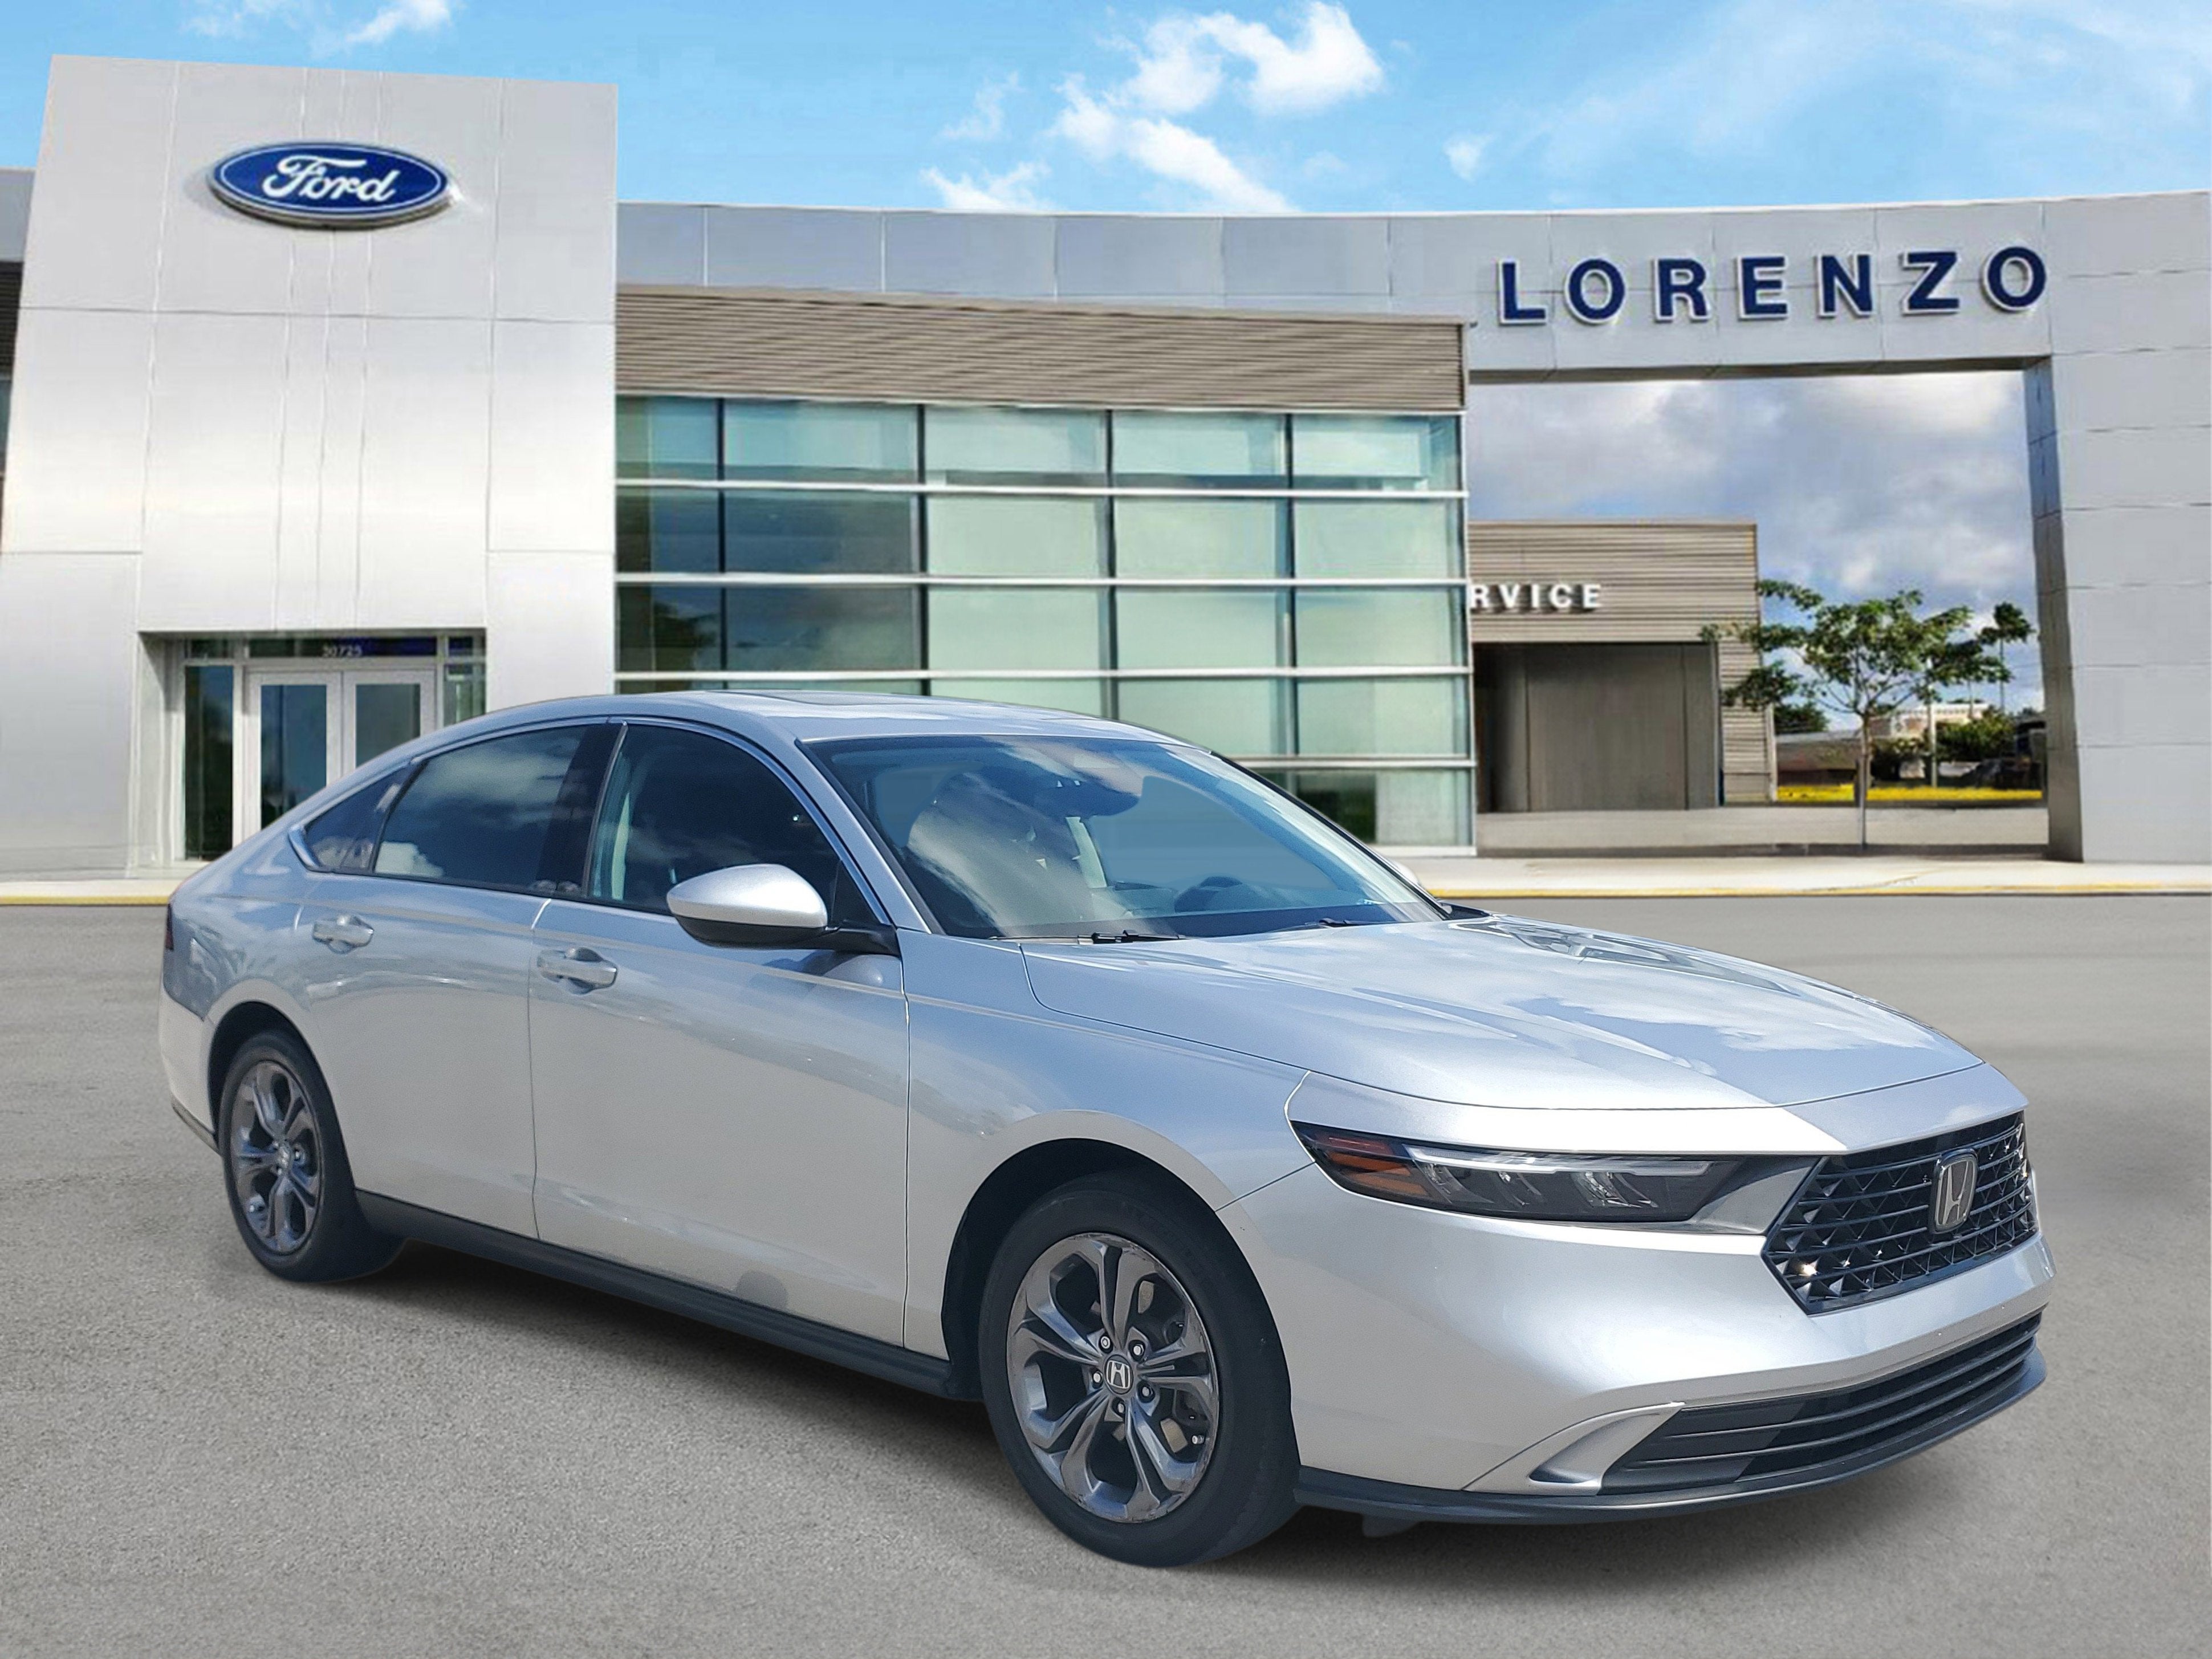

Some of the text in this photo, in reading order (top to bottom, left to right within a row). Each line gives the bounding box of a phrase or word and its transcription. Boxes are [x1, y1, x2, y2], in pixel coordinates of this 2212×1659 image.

[262, 154, 400, 202] Ford
[1499, 247, 2048, 323] LORENZO
[1469, 584, 1602, 608] RVICE
